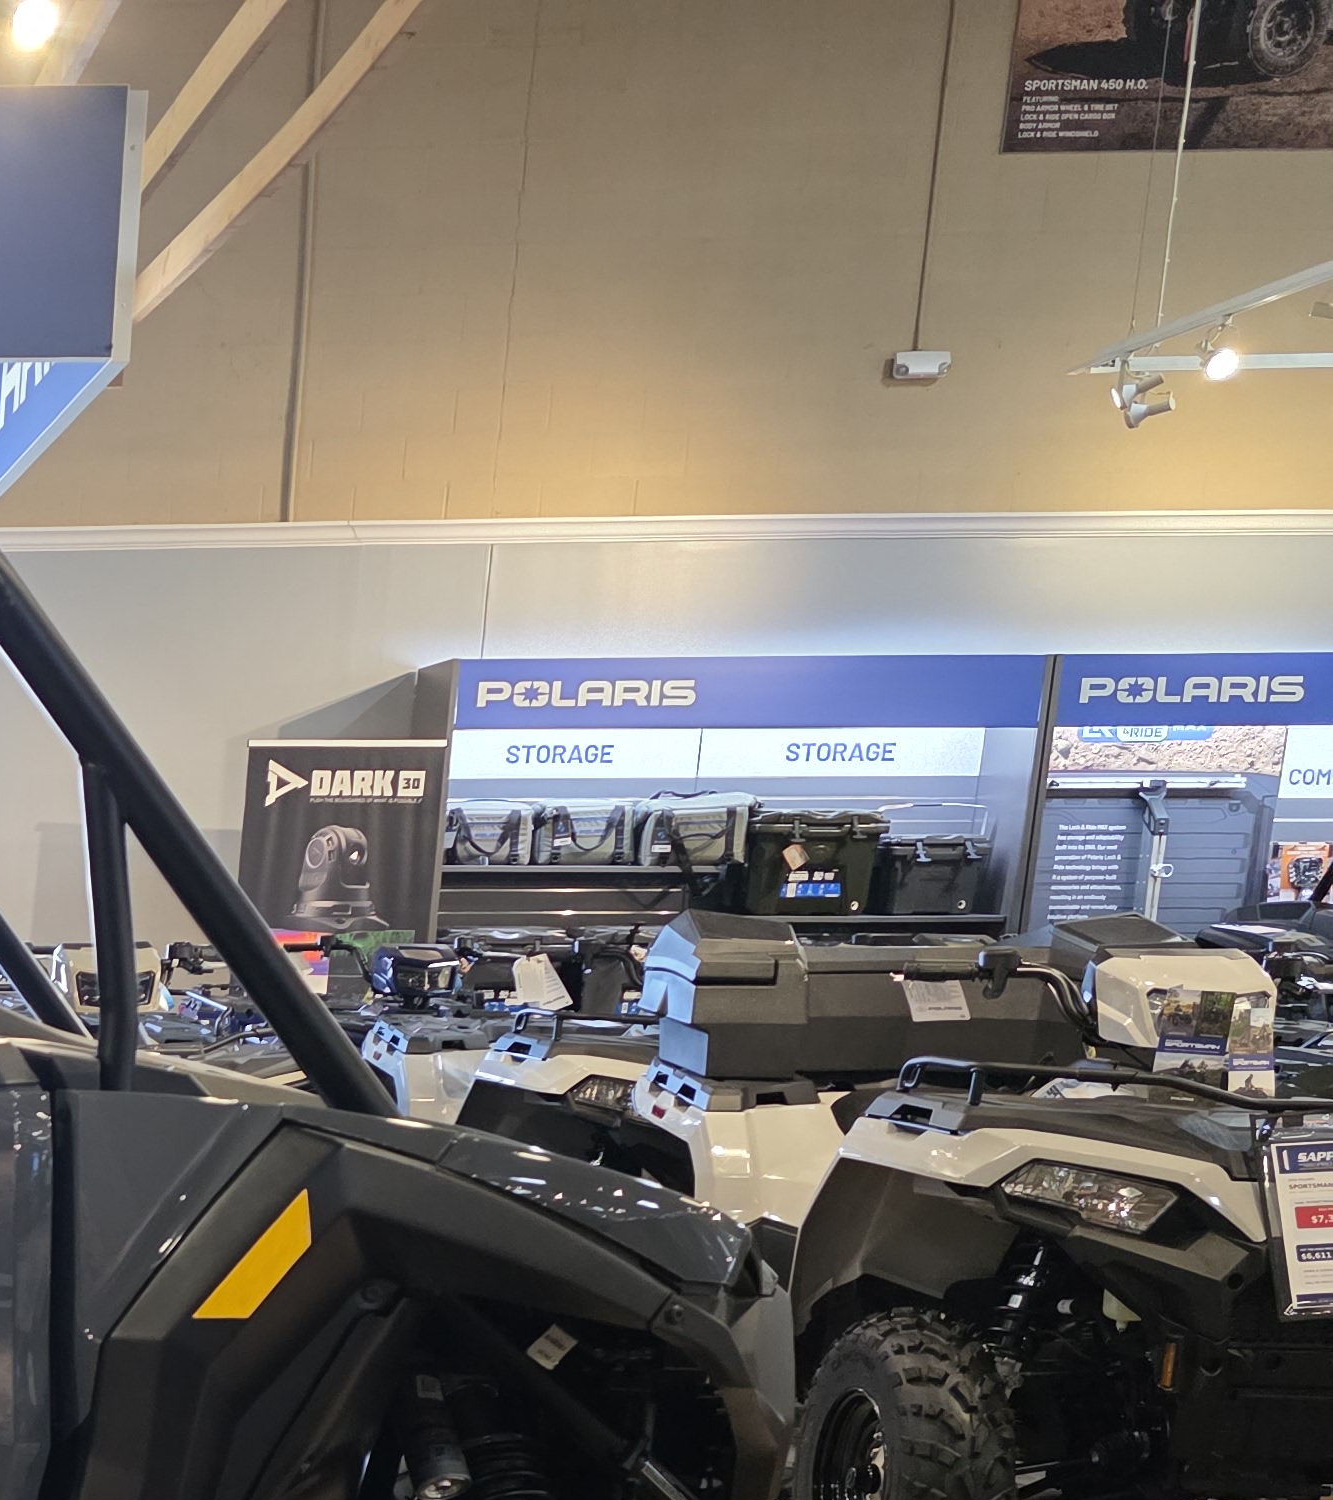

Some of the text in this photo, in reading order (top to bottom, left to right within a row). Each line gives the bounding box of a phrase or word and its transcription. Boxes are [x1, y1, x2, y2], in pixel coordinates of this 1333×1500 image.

[1024, 79, 1148, 91] SPORTSMAN 450 H.O.
[476, 679, 696, 708] POLARIS
[1078, 675, 1305, 704] POLARIS
[505, 743, 614, 765] STORAGE
[785, 742, 896, 763] STORAGE
[310, 770, 394, 796] DARK
[1289, 769, 1332, 786] COM
[1301, 1251, 1332, 1260] $6,611
